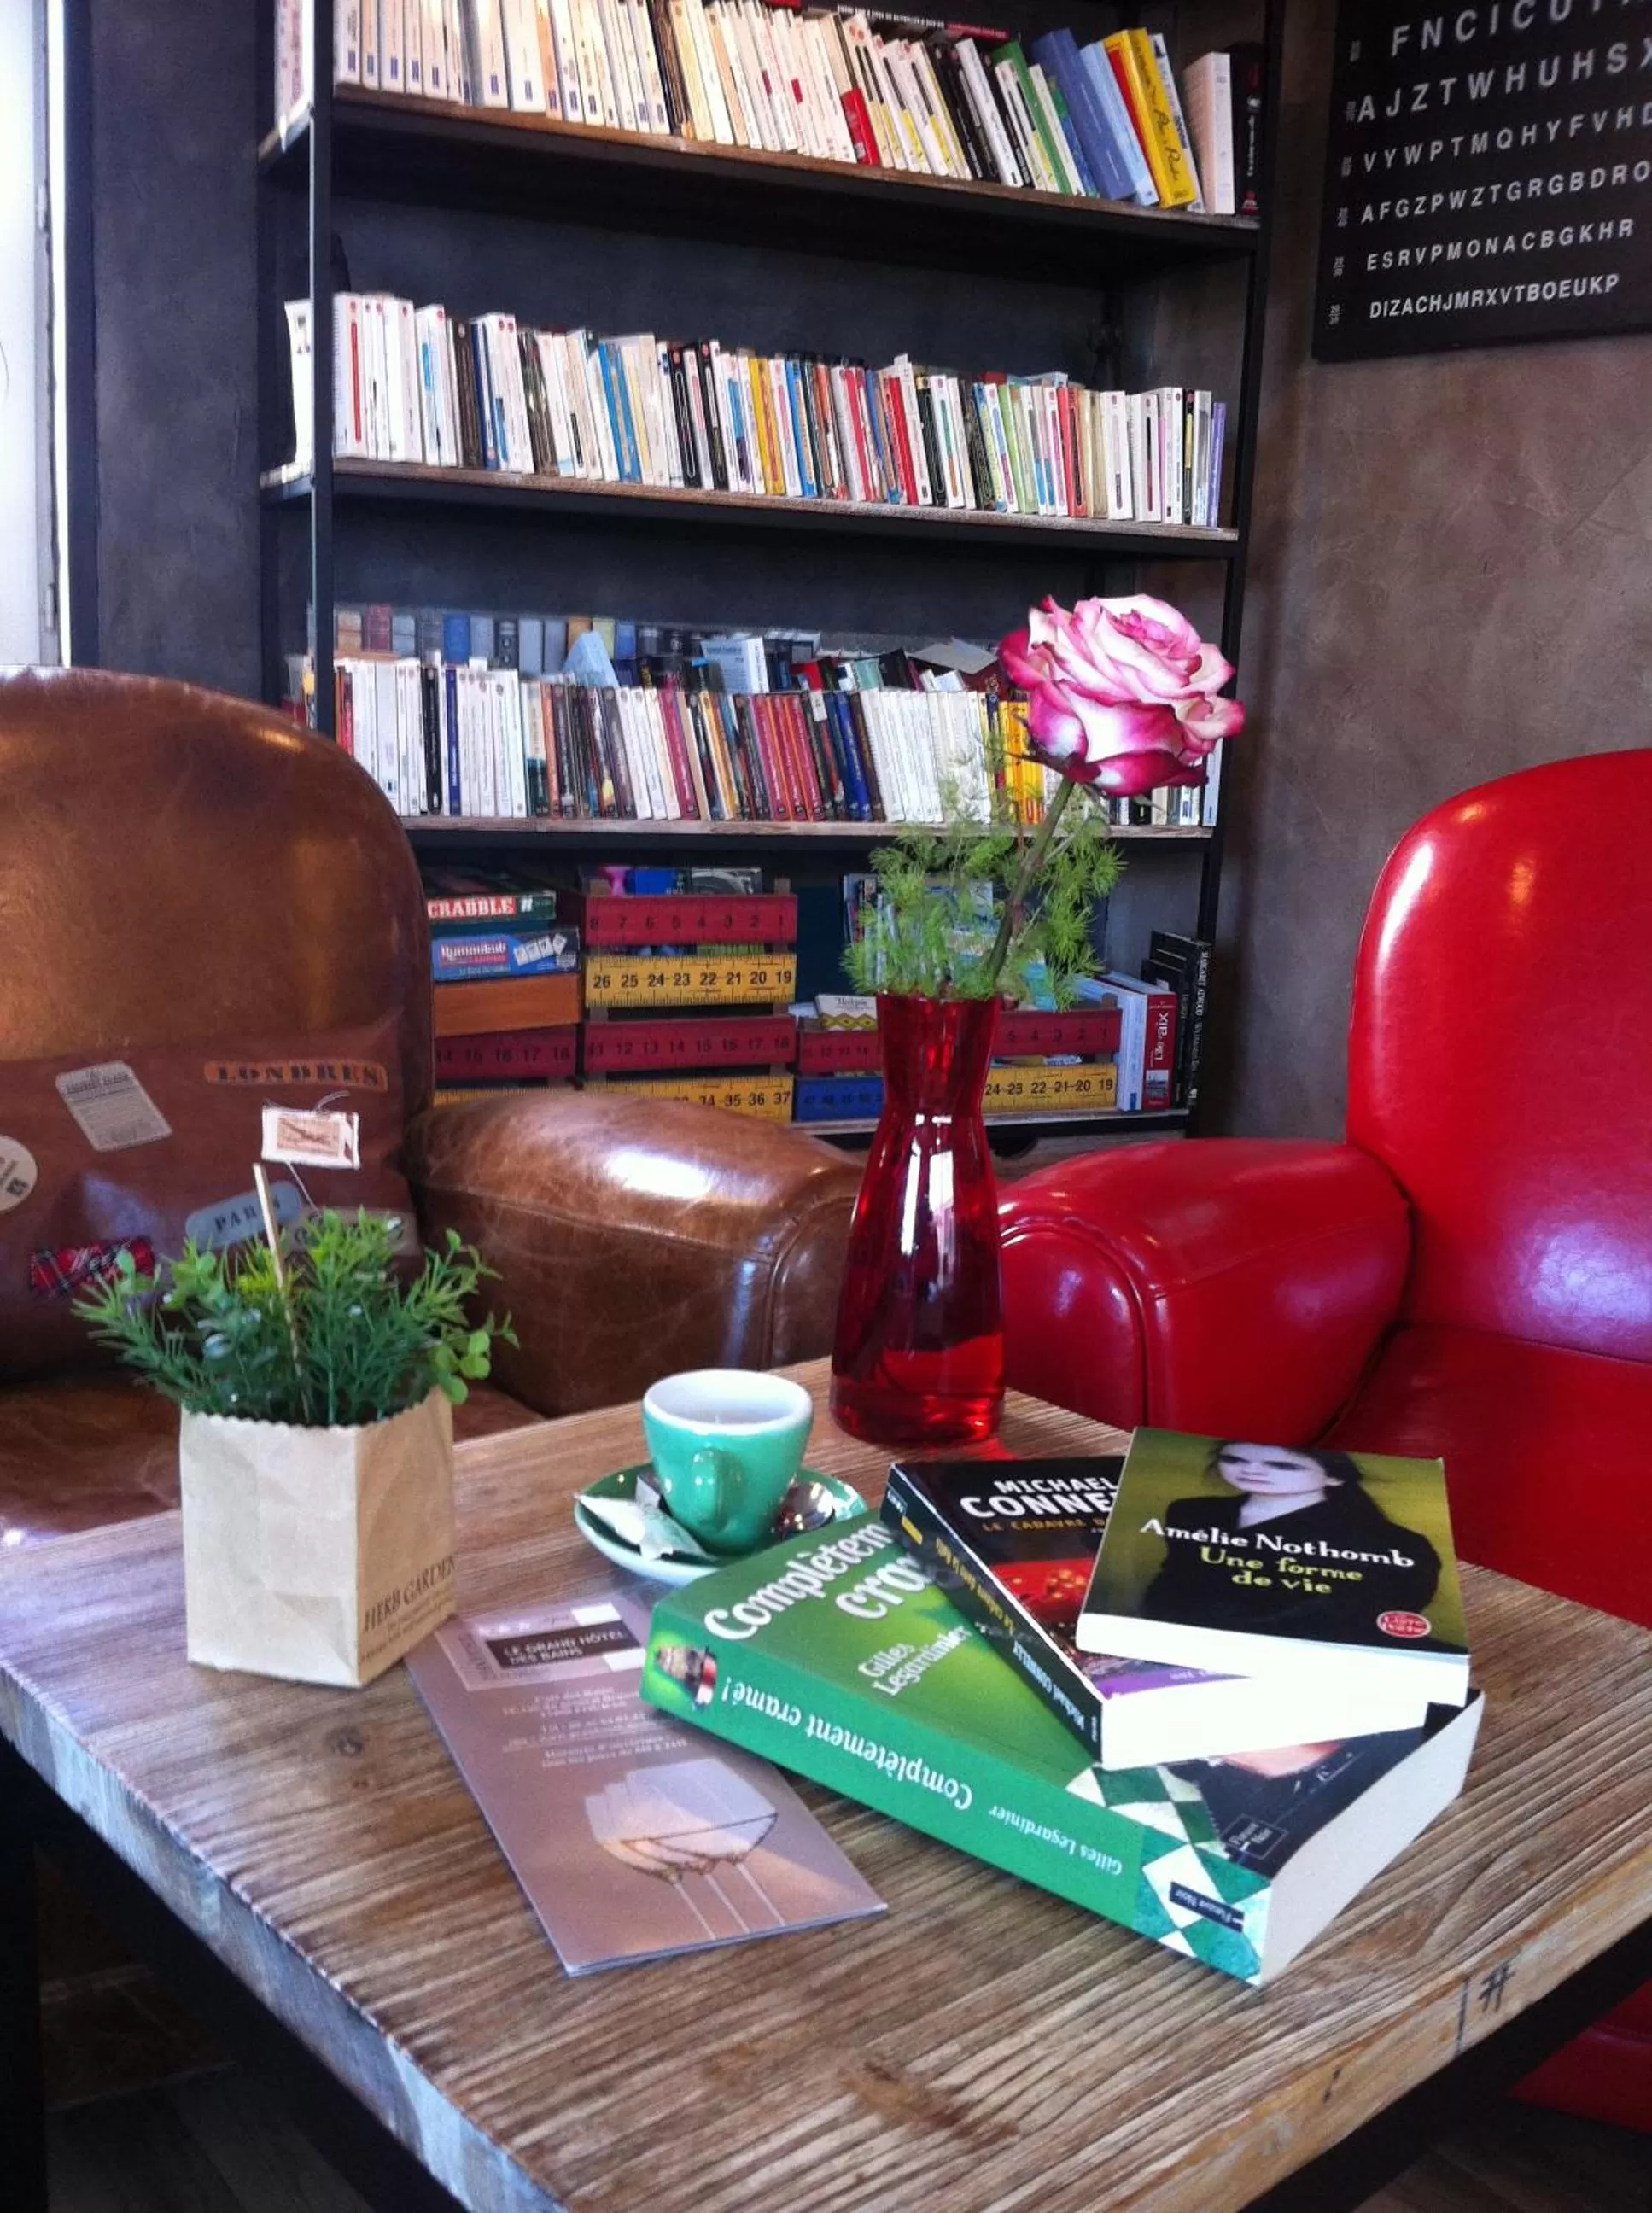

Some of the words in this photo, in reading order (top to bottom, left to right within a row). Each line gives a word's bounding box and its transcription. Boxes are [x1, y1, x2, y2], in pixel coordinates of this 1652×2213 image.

[1367, 219, 1633, 272] ESRVPMONACBGKHR
[1369, 273, 1620, 318] DIZACHJMRXVTBOEUKP
[427, 896, 516, 919] CRABBLE
[590, 918, 598, 929] 8
[619, 915, 628, 927] 7
[646, 915, 654, 929] 6
[672, 915, 681, 929] 5
[697, 915, 705, 927] 4
[725, 915, 733, 928] 3
[749, 914, 758, 927] 2
[778, 914, 785, 927] 1
[593, 975, 611, 989] 26
[621, 975, 639, 988] 25
[648, 974, 664, 986] 24
[673, 973, 691, 986] 23
[699, 972, 717, 985] 22
[726, 972, 741, 984] 21
[750, 971, 767, 984] 20
[775, 970, 792, 984] 19
[589, 1042, 604, 1056] 11
[617, 1042, 633, 1055] 12
[644, 1042, 658, 1054] 13
[669, 1040, 686, 1052] 14
[697, 1040, 712, 1053] 15
[721, 1039, 738, 1052] 16
[748, 1038, 762, 1050] 17
[773, 1037, 789, 1049] 18
[217, 1061, 380, 1088] LONDRES
[985, 1083, 1001, 1095] 24
[1007, 1082, 1023, 1095] 23
[1031, 1081, 1047, 1094] 22
[1054, 1080, 1068, 1092] 21
[1075, 1079, 1091, 1092] 20
[1100, 1078, 1113, 1090] 19
[724, 1094, 741, 1107] 35
[748, 1092, 765, 1106] 36
[773, 1091, 791, 1105] 37
[214, 1195, 283, 1232] PARS
[994, 1477, 1118, 1494] MICHAEL
[960, 1492, 1117, 1518] CONNE
[983, 1521, 1003, 1532] LE
[1139, 1517, 1248, 1548] Amélie
[1255, 1533, 1415, 1568] Nothomb
[1200, 1545, 1264, 1569] Une
[1277, 1556, 1365, 1581] forme
[704, 1522, 893, 1640] Complètem
[836, 1554, 932, 1619] cra
[1231, 1570, 1272, 1587] de
[1281, 1578, 1332, 1594] vie
[526, 1637, 576, 1655] GRAND
[540, 1647, 584, 1661] BAINS
[858, 1643, 917, 1678] Gilles
[873, 1625, 974, 1697] Legardinier
[805, 1714, 972, 1811] Complètement
[989, 1805, 1076, 1855] Legardinier
[1080, 1847, 1122, 1876] Gilles
